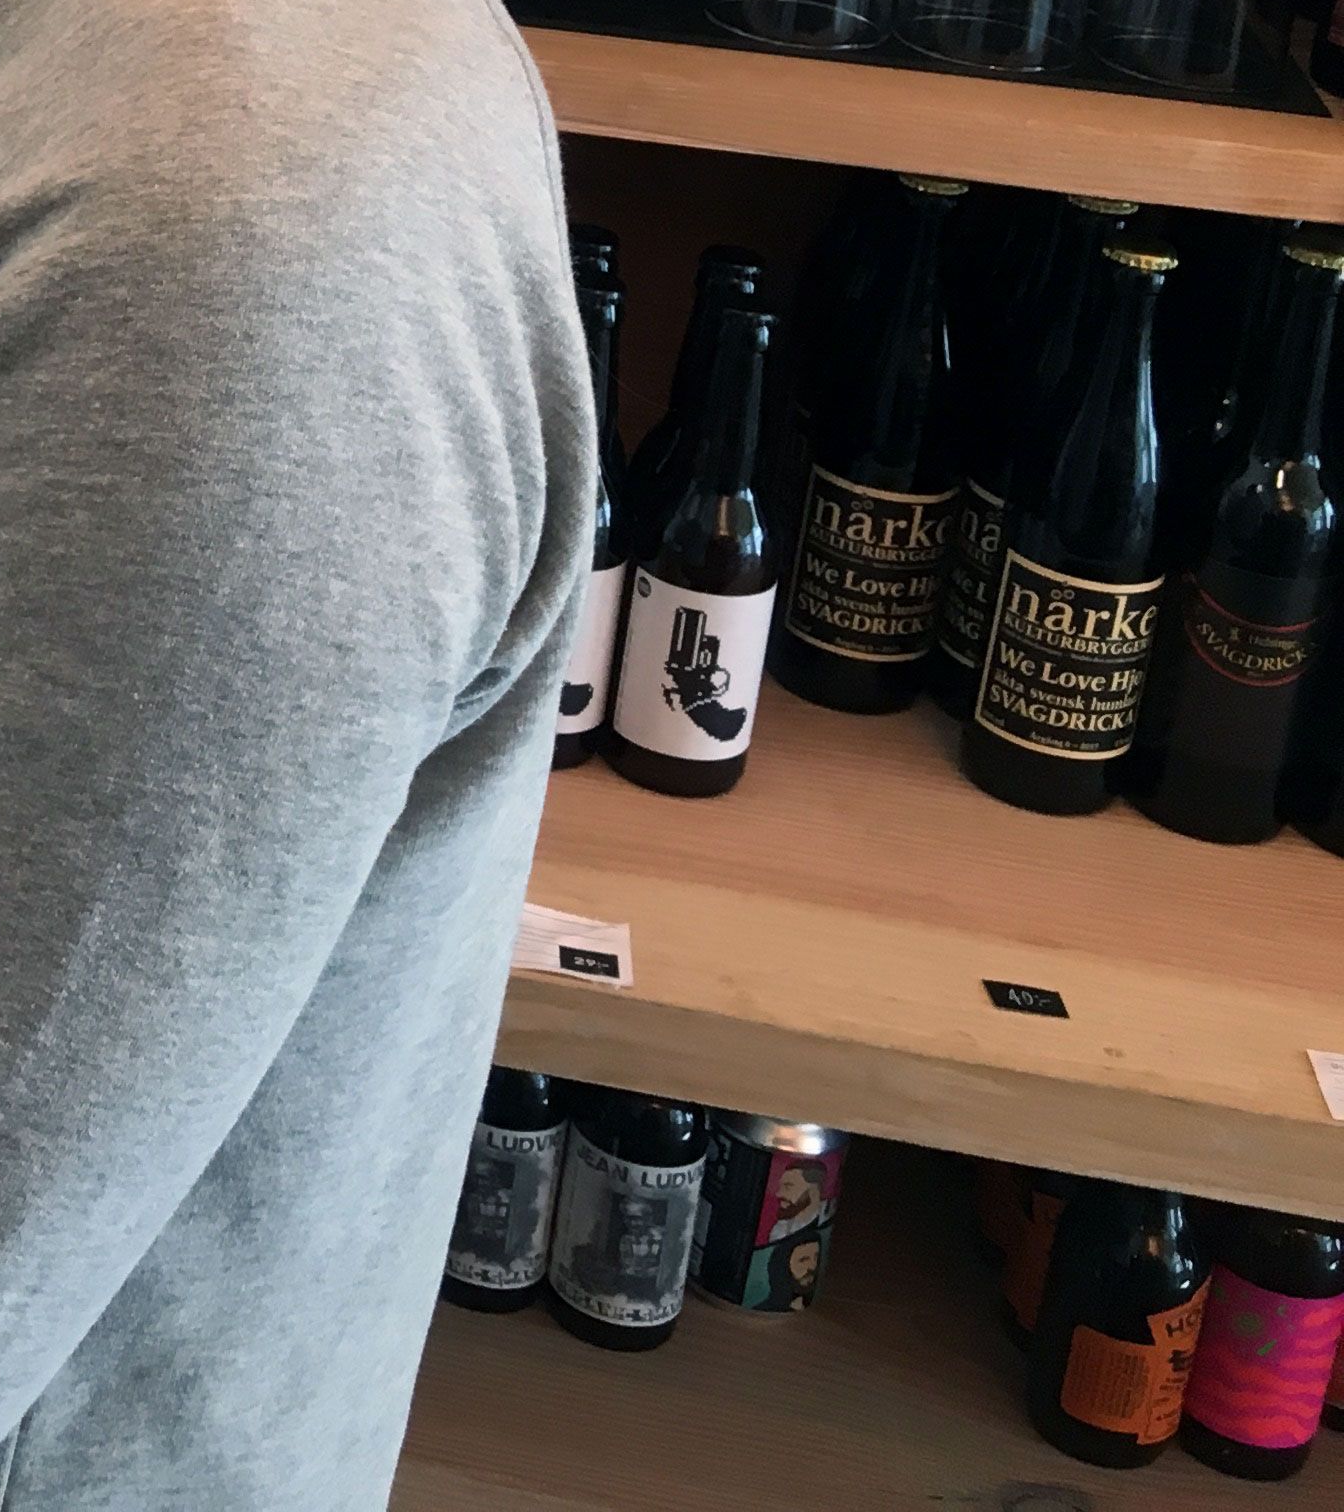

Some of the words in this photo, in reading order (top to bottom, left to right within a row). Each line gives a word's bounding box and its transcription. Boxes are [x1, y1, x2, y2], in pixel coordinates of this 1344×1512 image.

[806, 551, 839, 585] We
[843, 569, 905, 598] Love
[1006, 581, 1159, 641] närke
[999, 640, 1036, 677] We
[1040, 660, 1107, 692] Love
[1029, 686, 1086, 711] svensk
